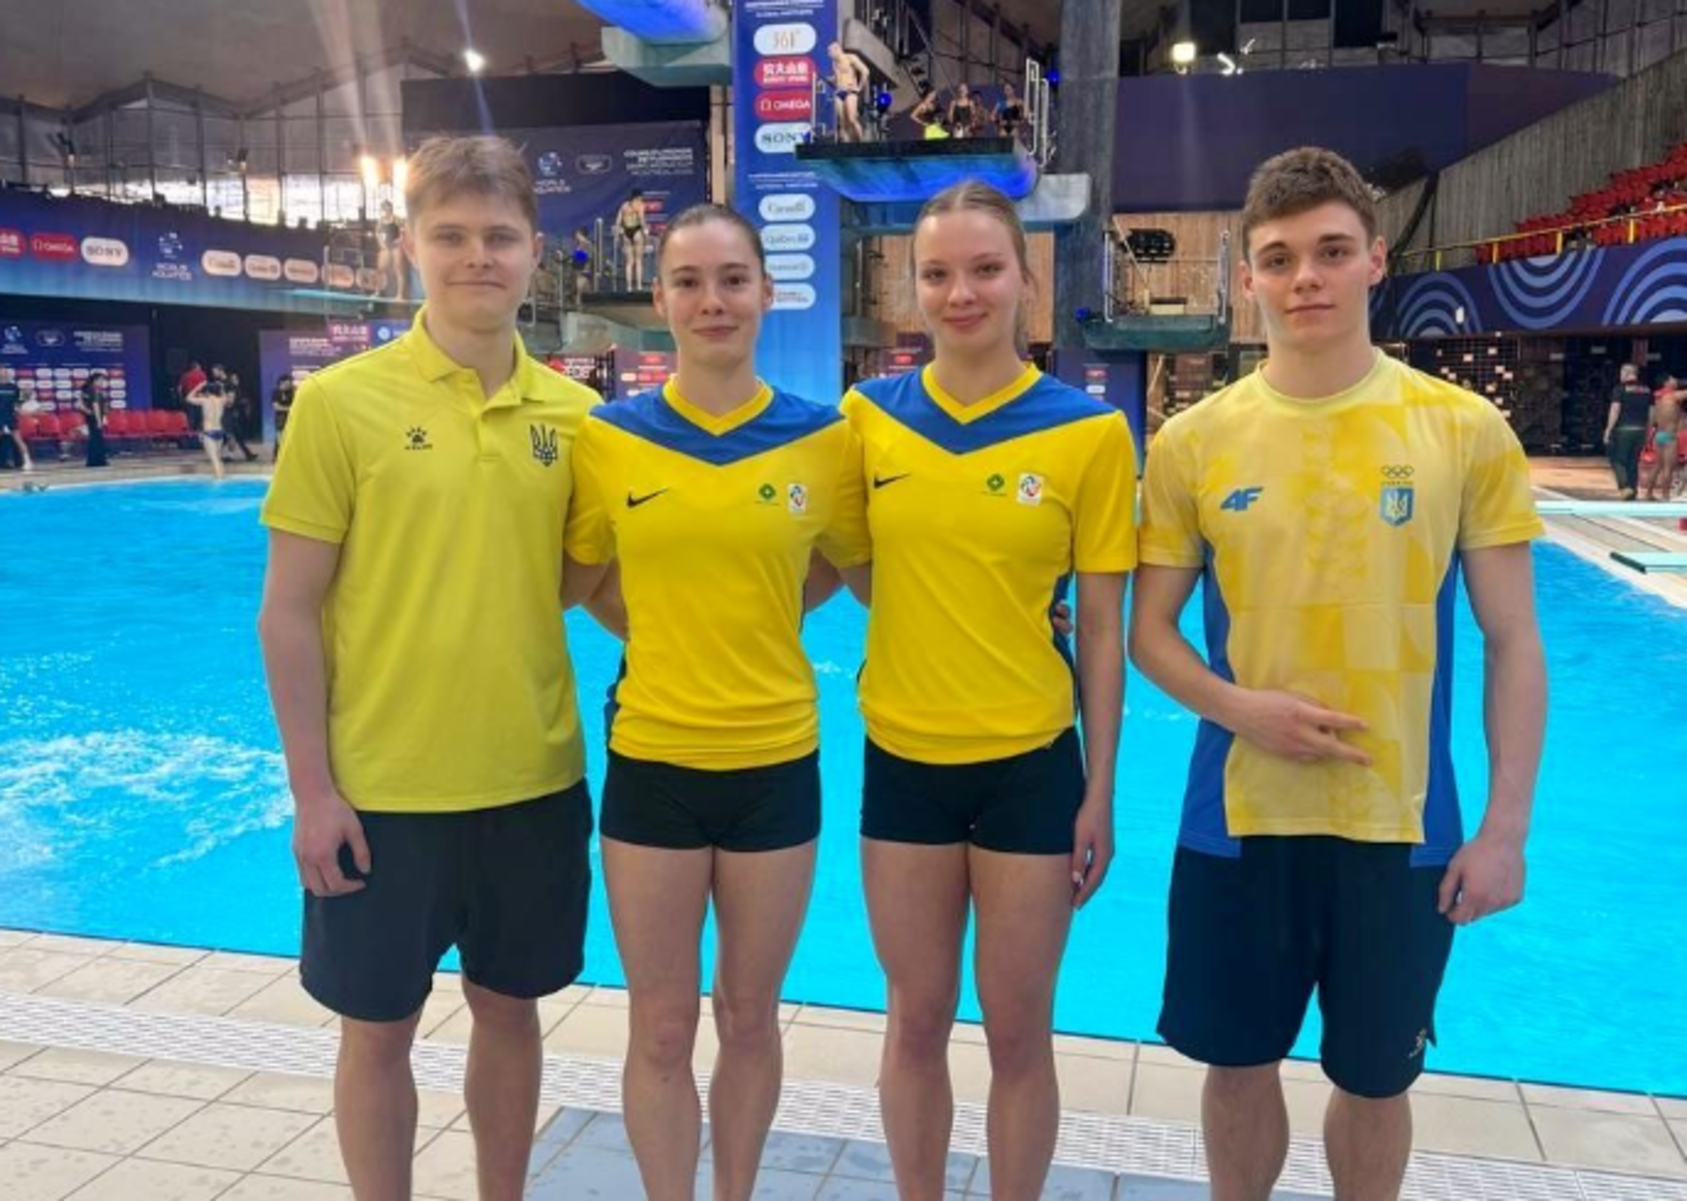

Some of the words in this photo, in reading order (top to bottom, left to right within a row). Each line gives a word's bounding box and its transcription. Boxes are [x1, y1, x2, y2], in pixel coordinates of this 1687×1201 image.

[773, 99, 811, 111] OMEGA
[85, 244, 123, 257] SONY
[1219, 485, 1264, 512] 4F
